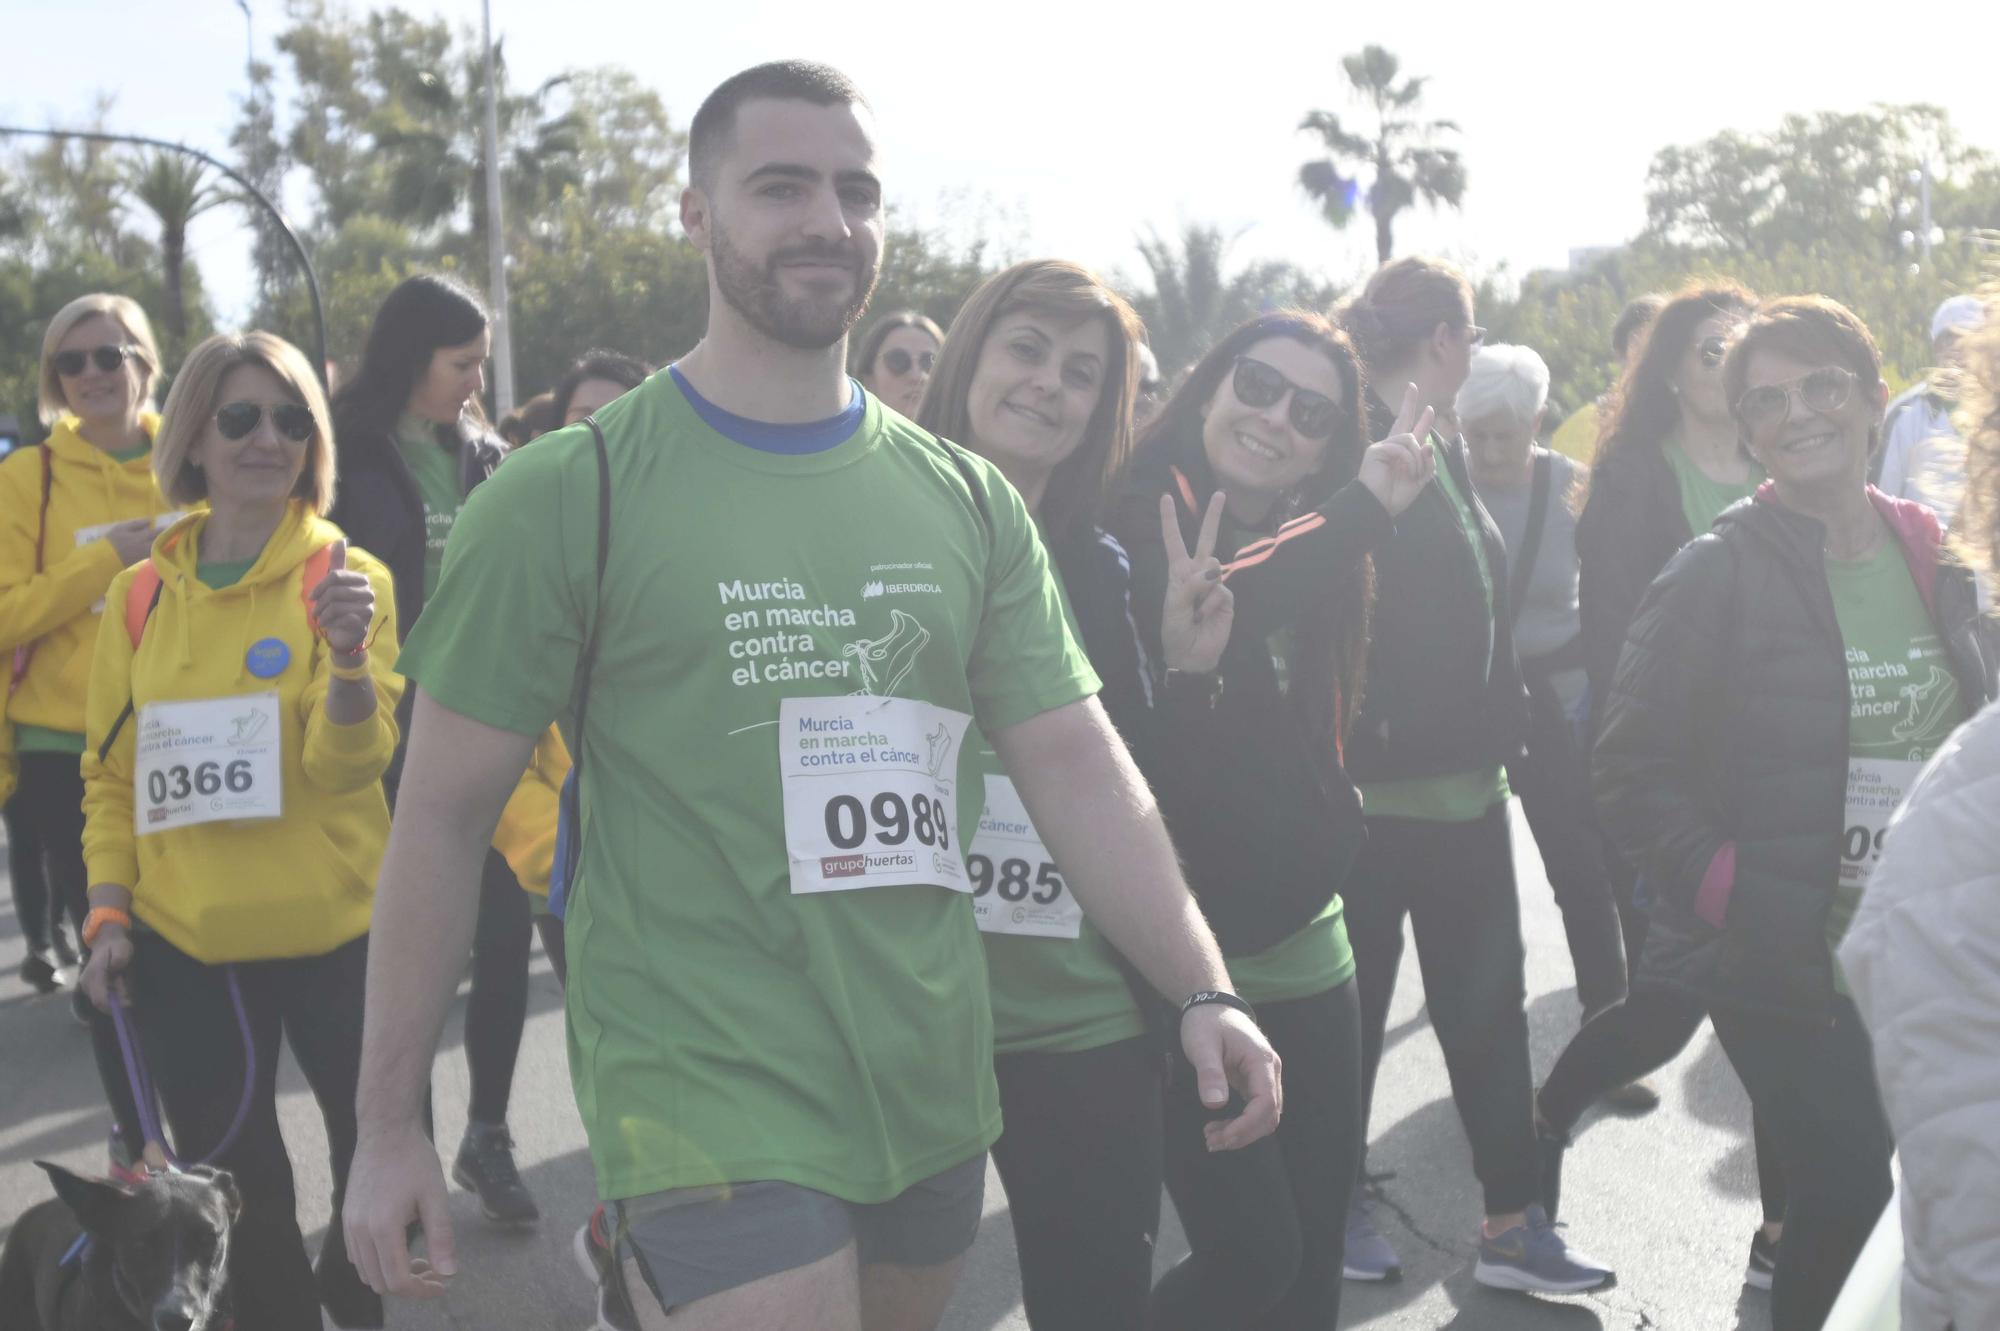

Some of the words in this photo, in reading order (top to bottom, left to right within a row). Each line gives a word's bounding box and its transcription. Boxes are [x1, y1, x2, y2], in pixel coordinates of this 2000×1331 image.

[718, 577, 806, 604] Murcia
[886, 583, 942, 594] IBERDROLA
[724, 610, 759, 631] en
[766, 604, 856, 627] marcha
[729, 633, 815, 659] contra
[732, 660, 761, 686] el
[764, 656, 850, 681] cáncer
[799, 716, 854, 732] Murcia
[162, 738, 172, 750] el
[174, 734, 215, 748] cáncer
[799, 735, 820, 750] en
[824, 731, 888, 748] marcha
[801, 750, 856, 767] contra
[860, 748, 876, 763] el
[880, 747, 920, 765] cáncer
[147, 759, 253, 806] 0366
[1857, 784, 1901, 797] marcha
[824, 791, 949, 851] 0989
[979, 818, 1030, 835] cáncer
[966, 853, 1062, 905] 985
